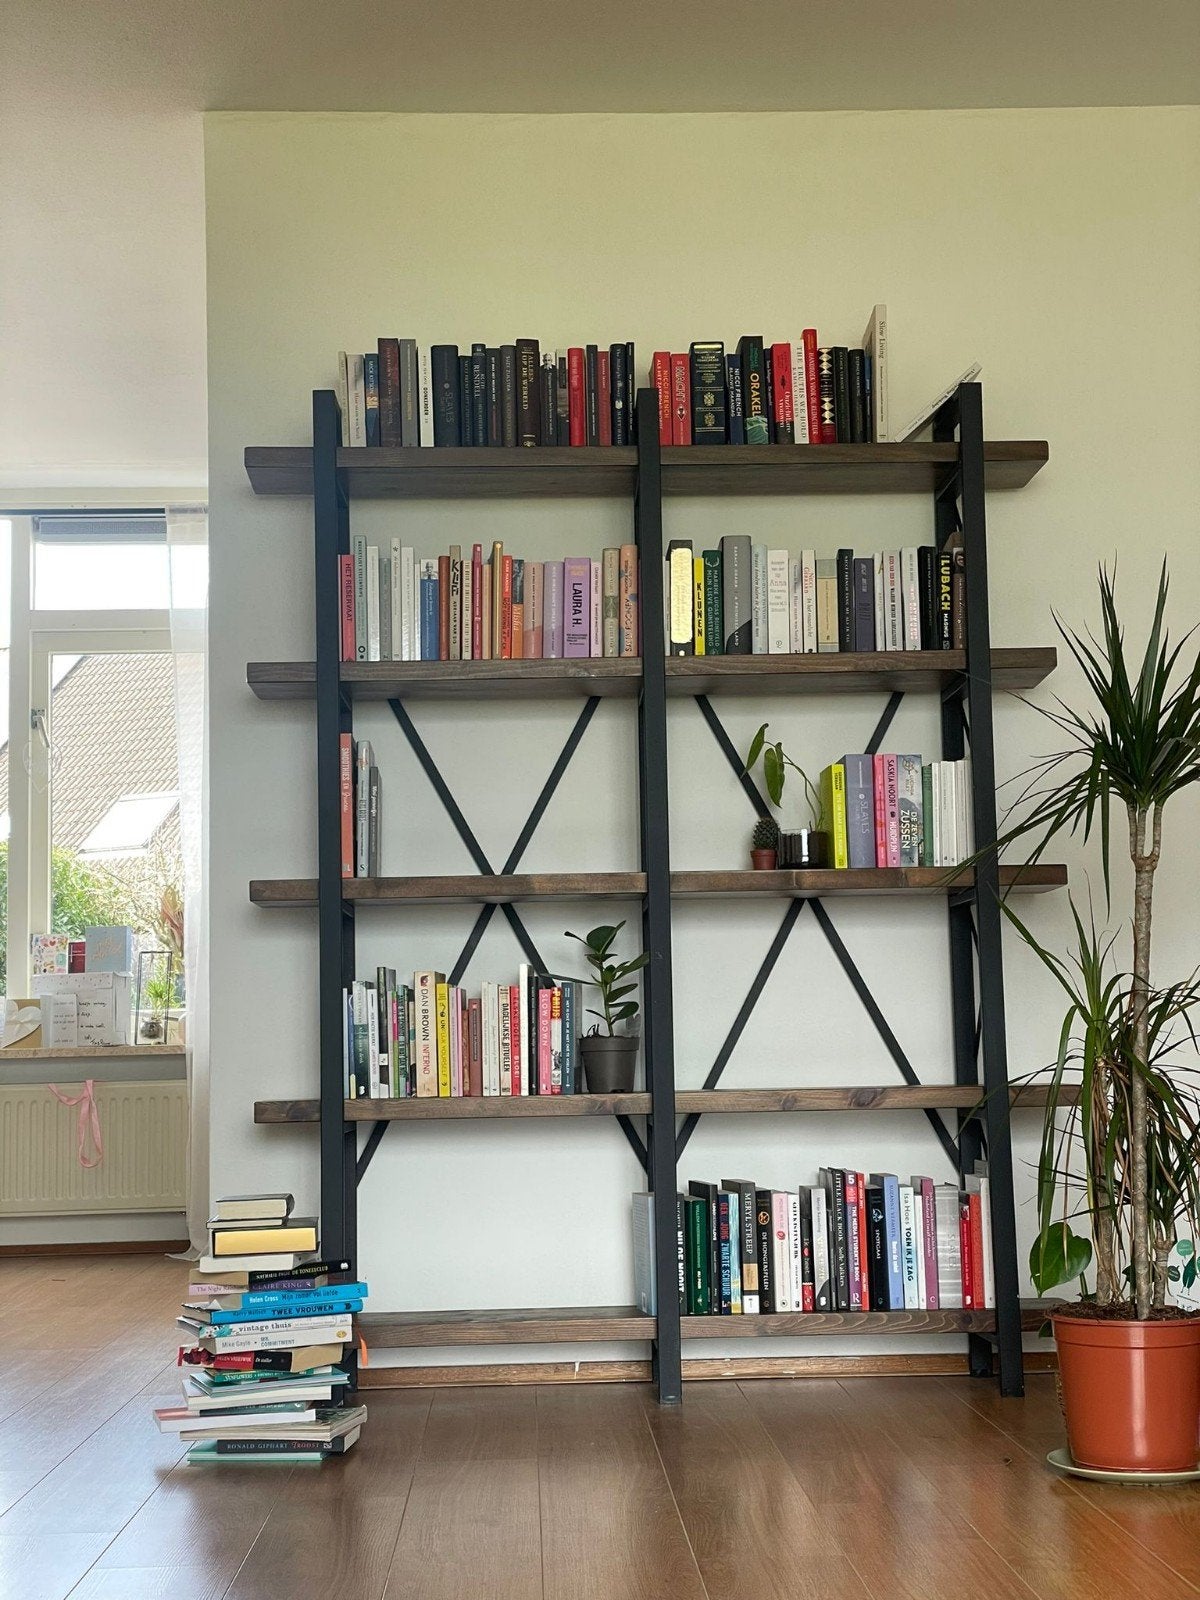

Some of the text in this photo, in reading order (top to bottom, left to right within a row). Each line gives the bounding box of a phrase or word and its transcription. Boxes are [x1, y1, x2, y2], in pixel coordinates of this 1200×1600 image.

[750, 372, 761, 416] ORAKEL
[941, 559, 951, 610] LUBACH
[572, 582, 582, 628] LAURA H.
[341, 747, 350, 781] SMOOTHIES
[888, 759, 896, 782] SASKIA
[861, 800, 870, 834] SLAVES
[900, 810, 911, 849] ZUSSEN
[911, 811, 918, 822] DE
[890, 821, 898, 852] HUIDPIJN
[421, 988, 429, 1007] DAN
[720, 1222, 729, 1240] JONG
[721, 1243, 731, 1296] ZWARTE SCHUUR
[250, 1296, 264, 1304] Helen
[296, 1304, 334, 1314] VROUWEN
[238, 1324, 269, 1334] vintage
[236, 1340, 251, 1348] Gayle
